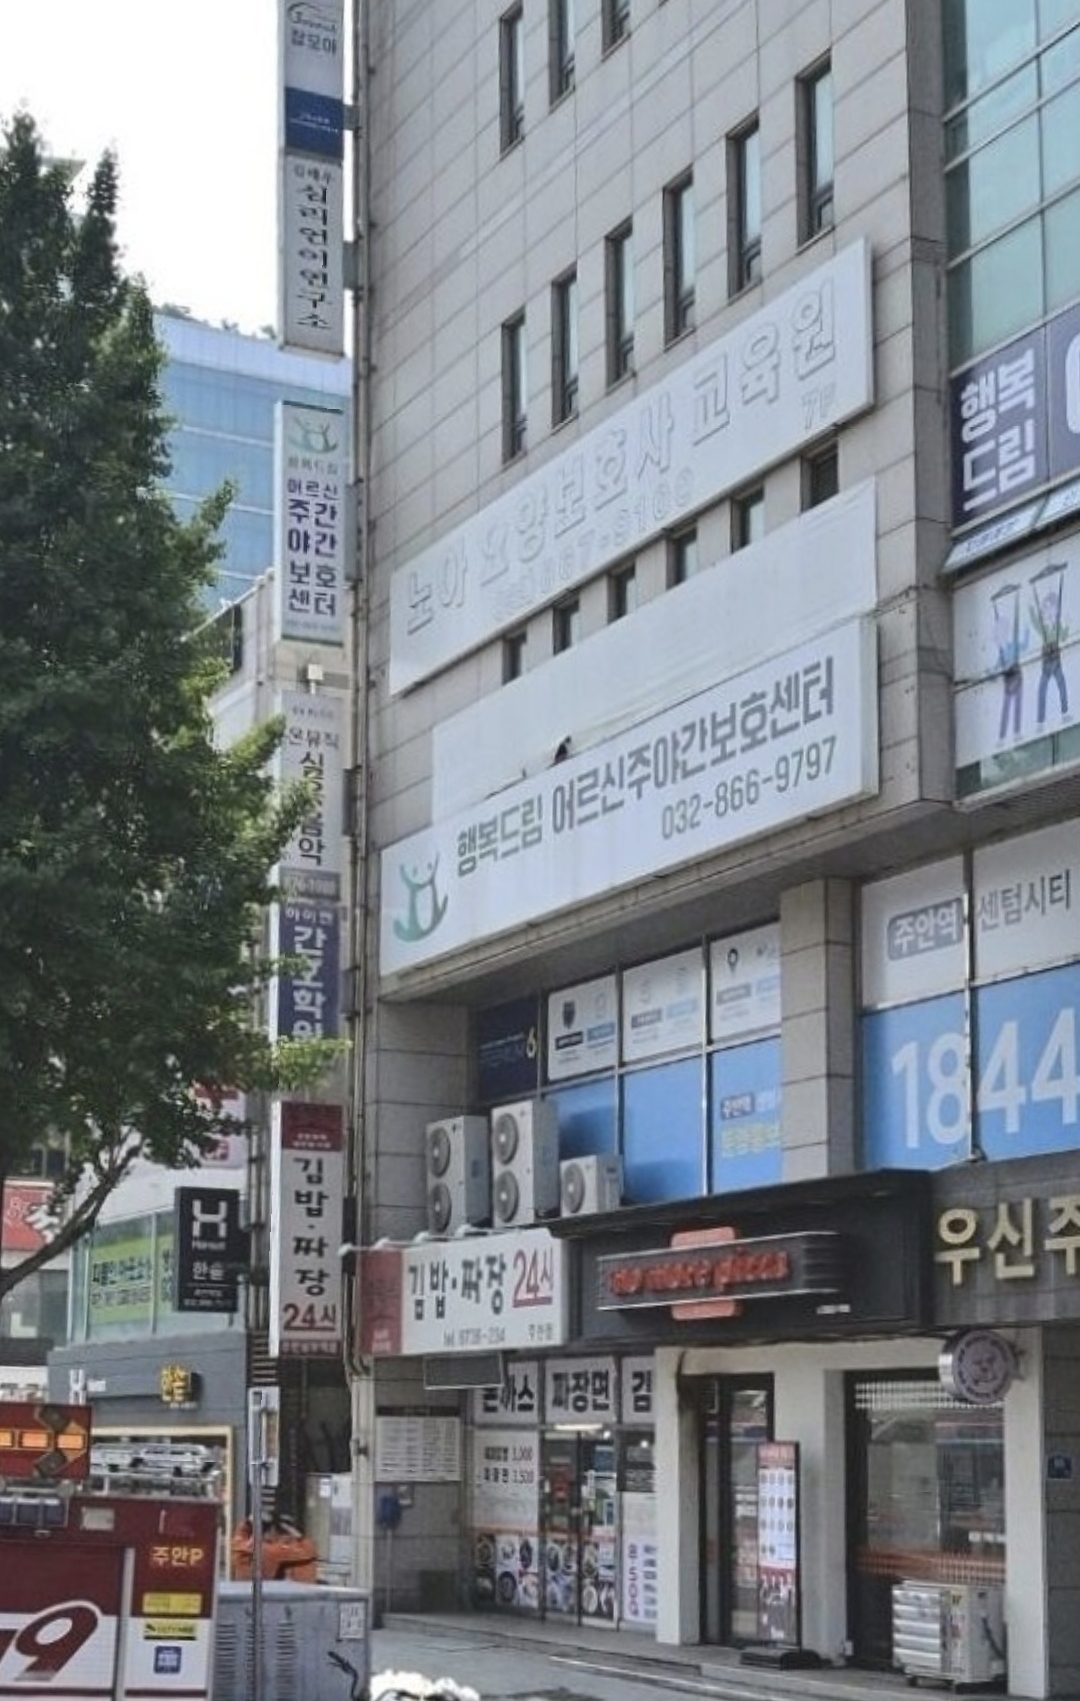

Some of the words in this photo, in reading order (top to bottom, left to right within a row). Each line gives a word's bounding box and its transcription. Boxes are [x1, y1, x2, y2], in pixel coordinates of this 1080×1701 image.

[960, 348, 1036, 443] 행복
[406, 560, 468, 636] 노아
[480, 390, 676, 587] 요양보호사
[693, 276, 836, 448] 교육원
[963, 418, 1036, 512] 드림
[287, 477, 339, 501] 어르신
[288, 528, 338, 559] 야간
[289, 587, 337, 618] 센터
[290, 561, 338, 588] 보호
[456, 796, 543, 879] 행복드림
[551, 655, 835, 836] 어르신주야간보호센터
[660, 734, 837, 841] 032-866-9797
[892, 900, 960, 953] 주안역
[976, 868, 1071, 934] 센텀시티
[934, 1196, 1080, 1287] 우신주
[512, 1247, 554, 1308] 24시
[283, 1302, 337, 1332] 24시
[552, 1370, 610, 1413] 짜장면
[152, 1546, 204, 1567] 주안P
